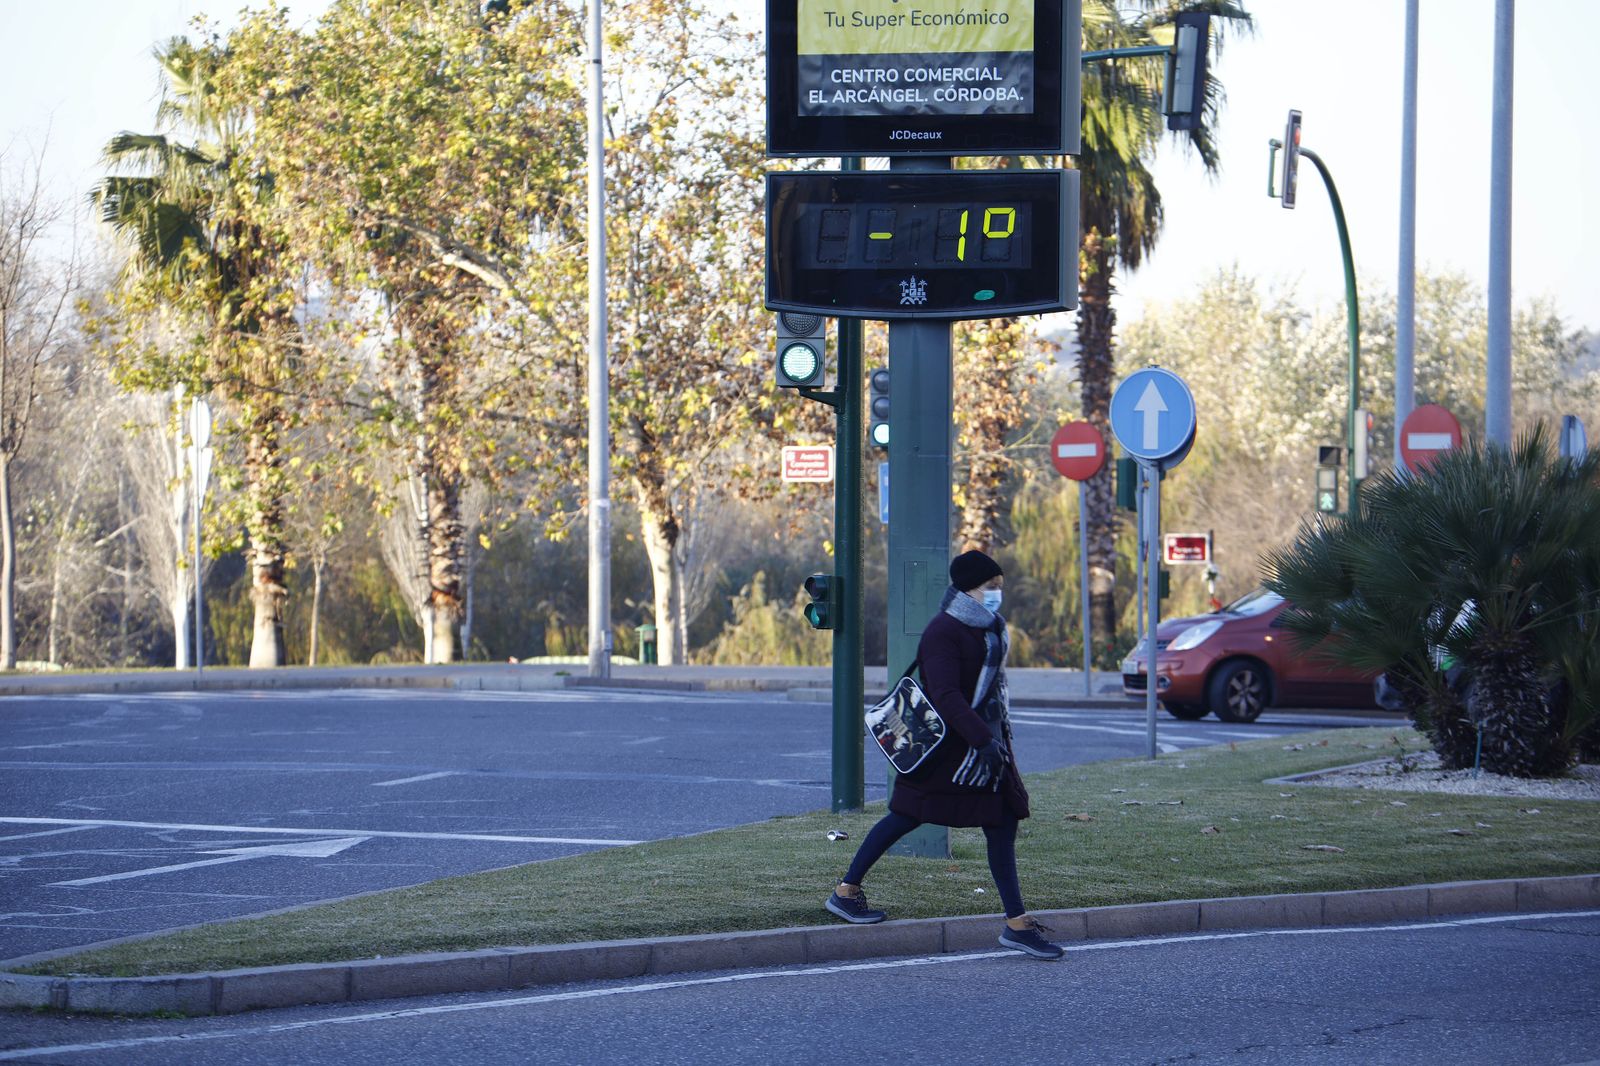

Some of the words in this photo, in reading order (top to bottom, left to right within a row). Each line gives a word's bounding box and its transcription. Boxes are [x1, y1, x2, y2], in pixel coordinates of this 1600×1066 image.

[824, 11, 845, 28] Tu
[852, 10, 905, 30] Super
[912, 9, 1009, 27] Económico
[831, 68, 898, 83] CENTRO
[904, 67, 1003, 82] COMERCIAL
[809, 89, 828, 104] EL
[832, 86, 928, 104] ARCÁNGEL.
[934, 85, 1024, 102] CÓRDOBA.
[889, 130, 942, 140] JCDecaux
